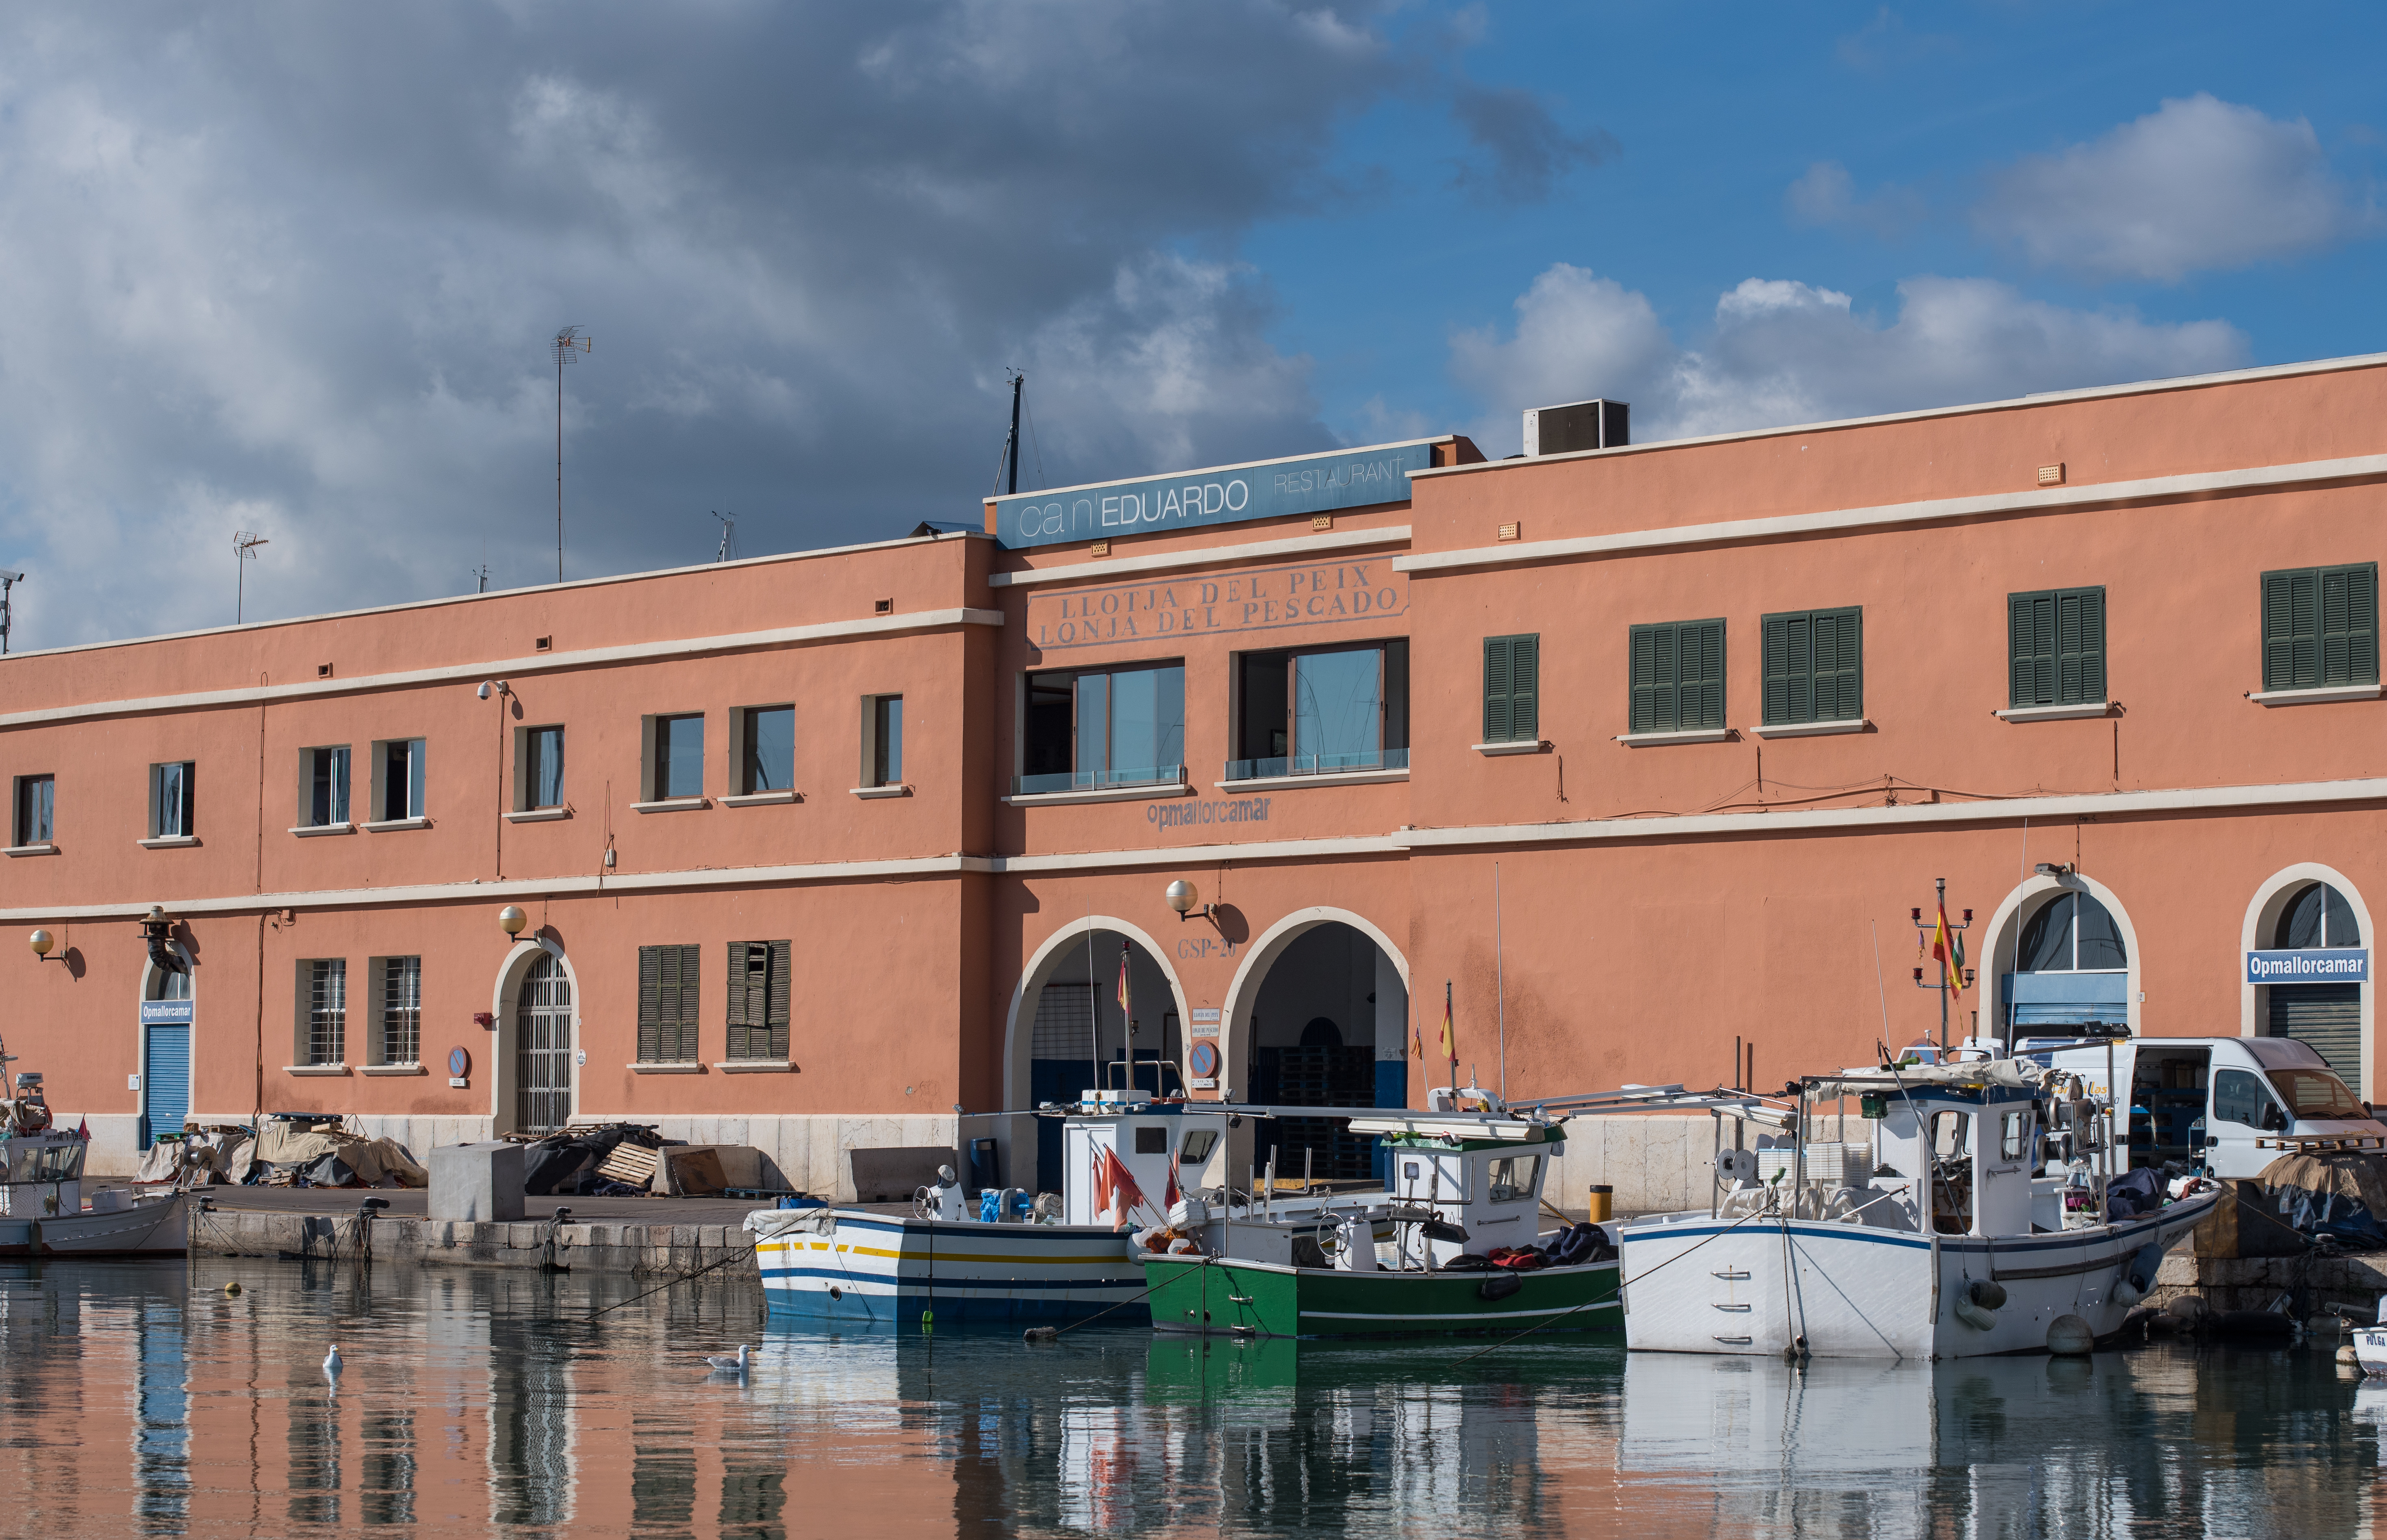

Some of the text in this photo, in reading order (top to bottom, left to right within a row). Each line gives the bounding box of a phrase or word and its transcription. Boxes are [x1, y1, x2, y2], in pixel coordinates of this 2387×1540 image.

[1275, 458, 1405, 494] RESTAURANT
[1061, 565, 1370, 619] LLOTJA DEL PEIX
[1038, 587, 1397, 645] LONJA DEL PESCADO
[1147, 797, 1271, 832] opmallorcamar
[1177, 938, 1236, 959] GSP-20
[2250, 956, 2363, 978] Opmallorcamar
[143, 1005, 191, 1019] Opmallorcamar
[2051, 1082, 2107, 1097] Carillas
[2366, 1336, 2386, 1347] PULGA
